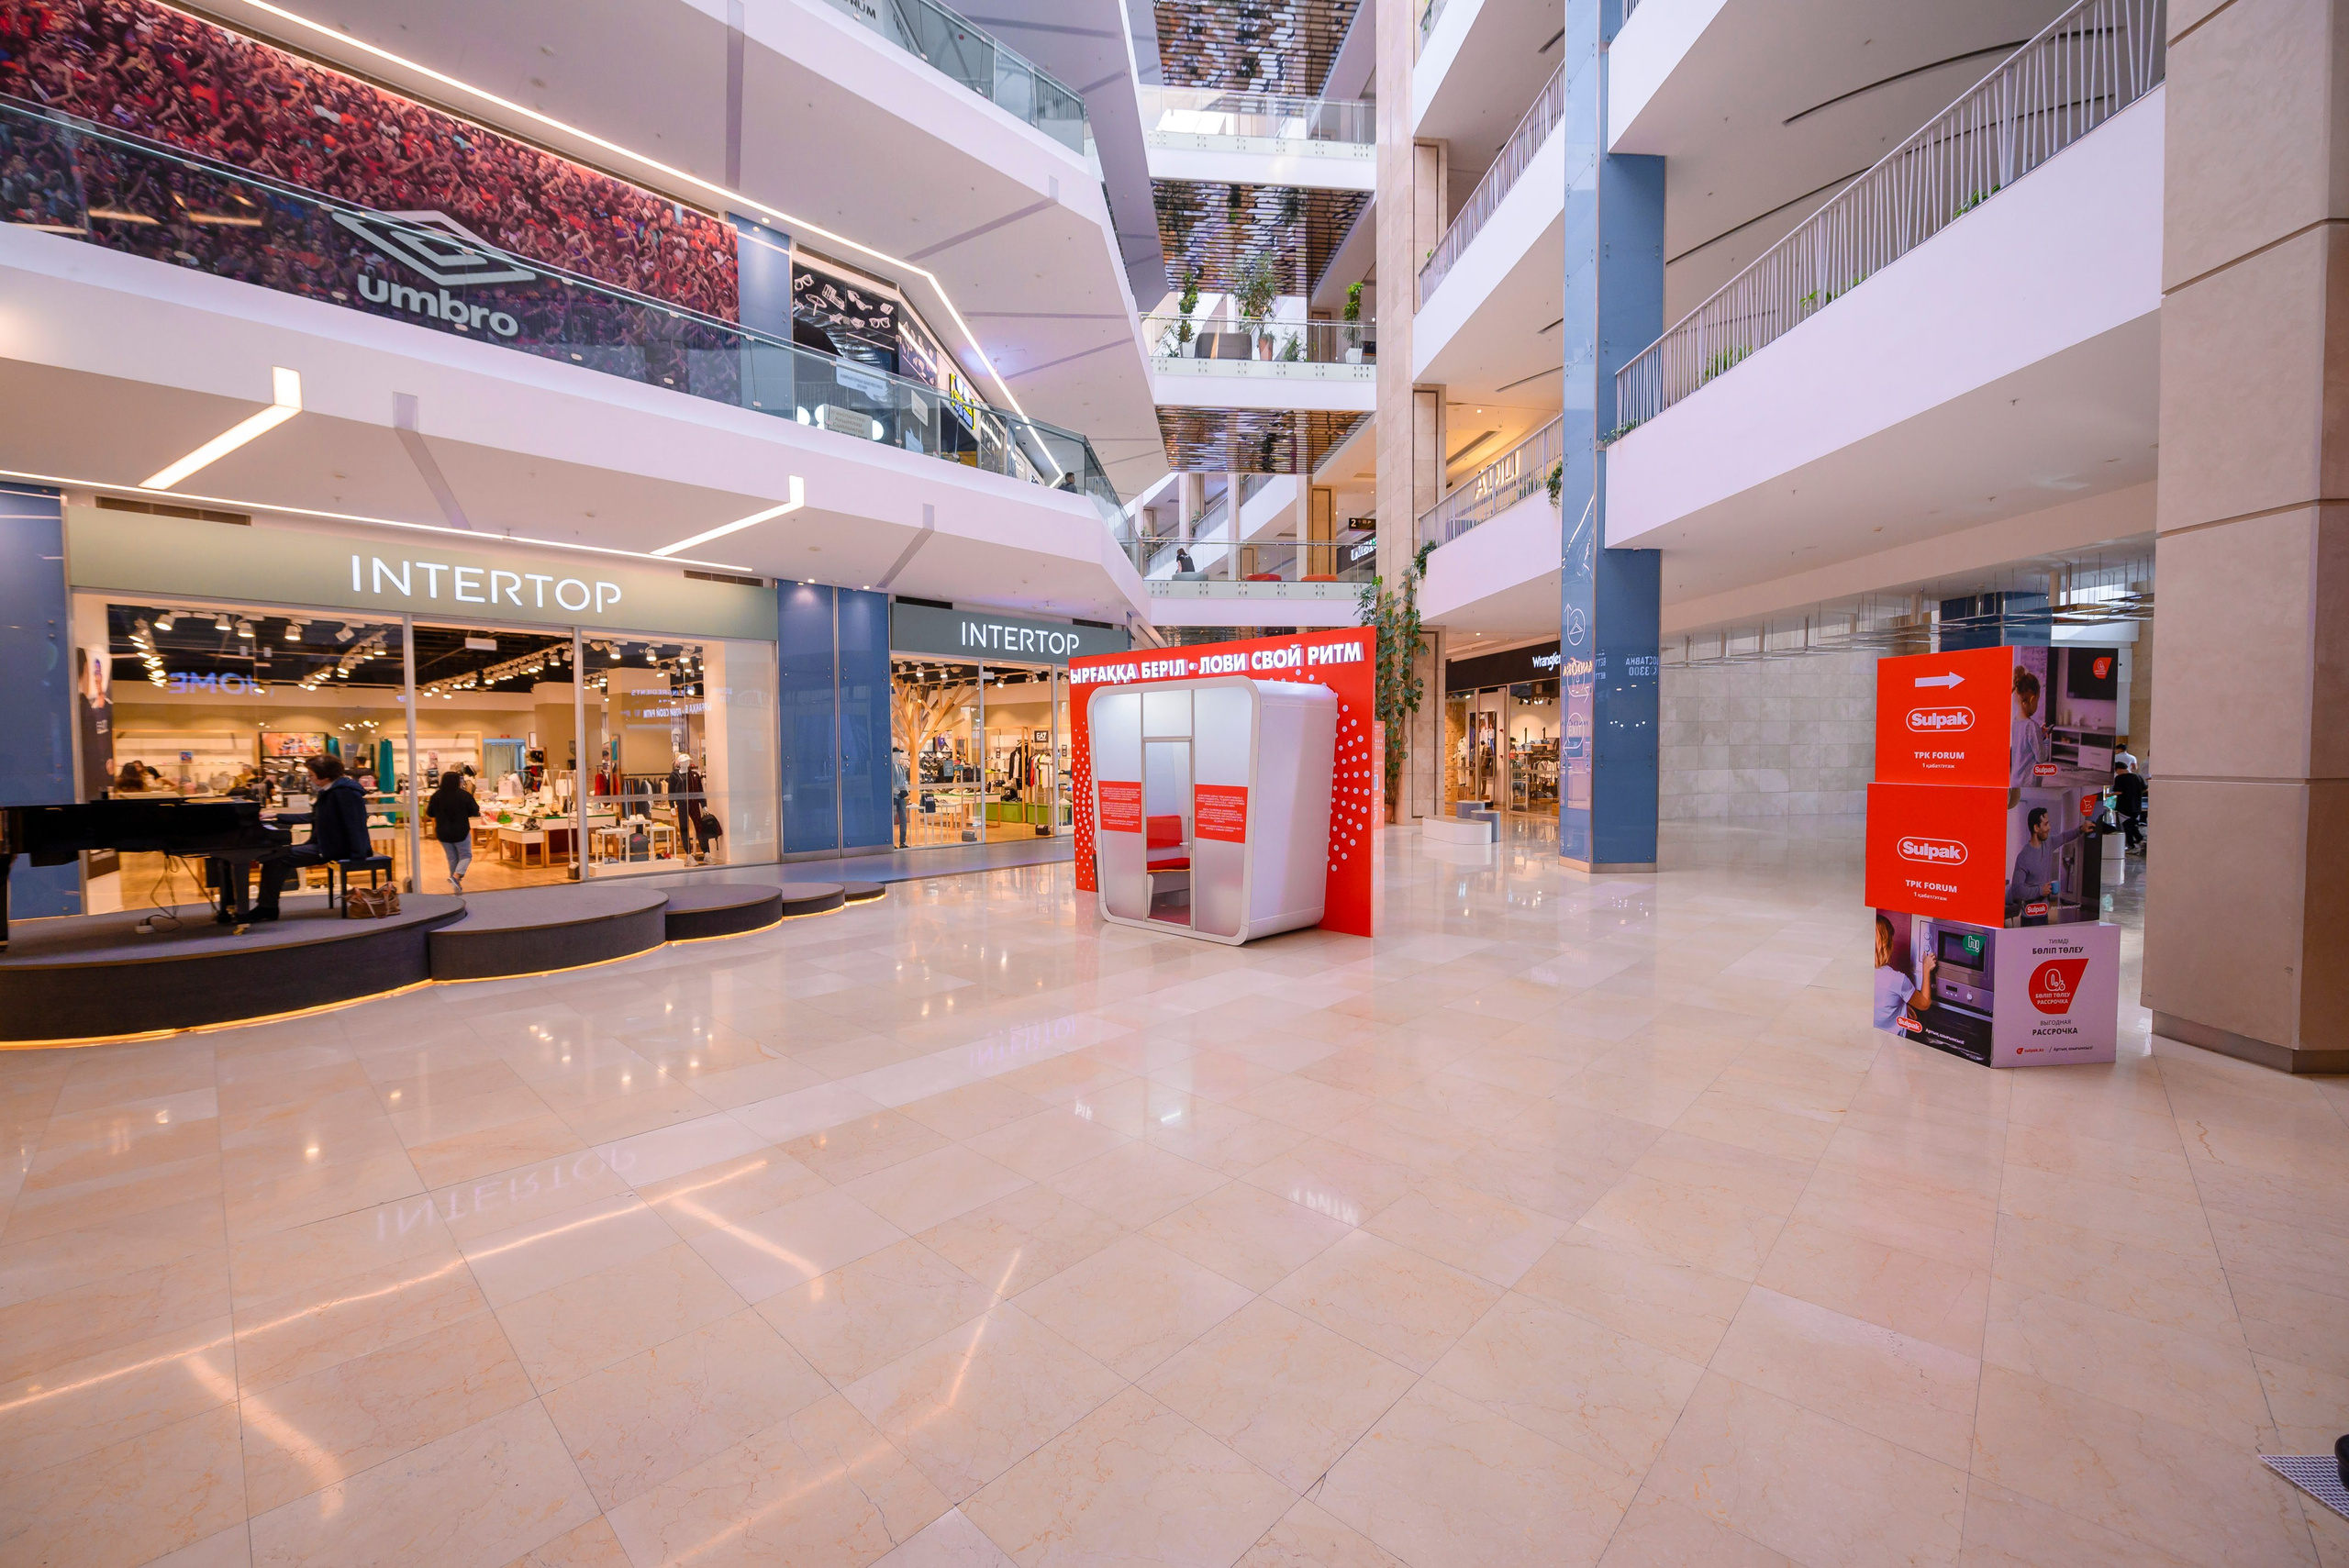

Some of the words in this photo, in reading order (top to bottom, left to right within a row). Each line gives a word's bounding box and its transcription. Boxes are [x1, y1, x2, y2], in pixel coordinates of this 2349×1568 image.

[844, 0, 876, 19] RUM
[357, 272, 520, 338] umbro
[351, 554, 622, 614] INTERTOP
[961, 620, 1080, 656] INTERTOP
[1070, 663, 1138, 684] ЫРҒАҚҚА
[1141, 659, 1186, 679] БЕРІЛ
[1198, 653, 1247, 674] ЛОВИ
[1252, 644, 1302, 670] СВОЙ
[1308, 641, 1364, 666] РИТМ
[1911, 712, 1968, 729] Sulpak
[1932, 751, 1965, 760] FORUM
[2034, 765, 2055, 775] Sulpak
[1902, 840, 1961, 860] Sulpak
[1924, 882, 1957, 893] FORUM
[2027, 905, 2046, 915] Sulpak
[1898, 1018, 1920, 1031] Sulpak
[2032, 1028, 2078, 1036] РАССРОЧКА
